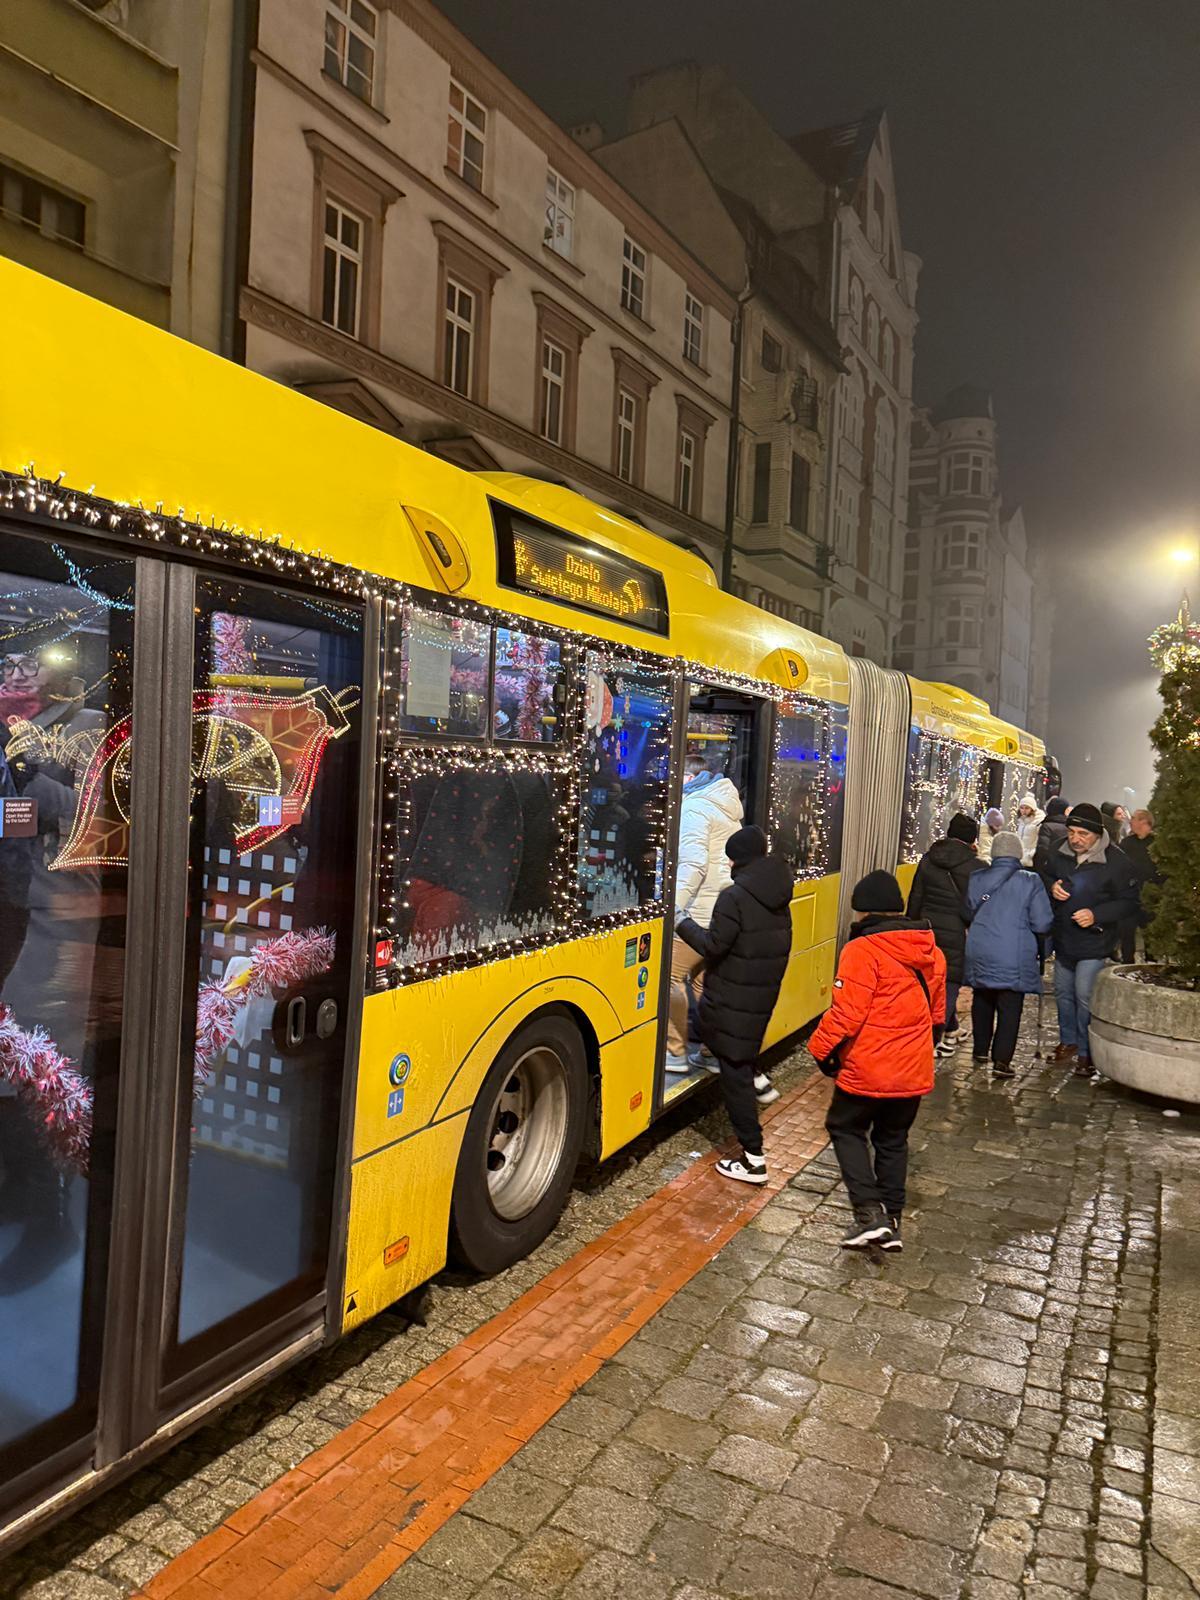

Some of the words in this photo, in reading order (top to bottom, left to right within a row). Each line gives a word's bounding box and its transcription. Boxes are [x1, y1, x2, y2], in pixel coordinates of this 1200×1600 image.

[566, 554, 601, 583] Dzieło
[530, 564, 583, 601] Świętego
[586, 583, 630, 616] Mikołaja
